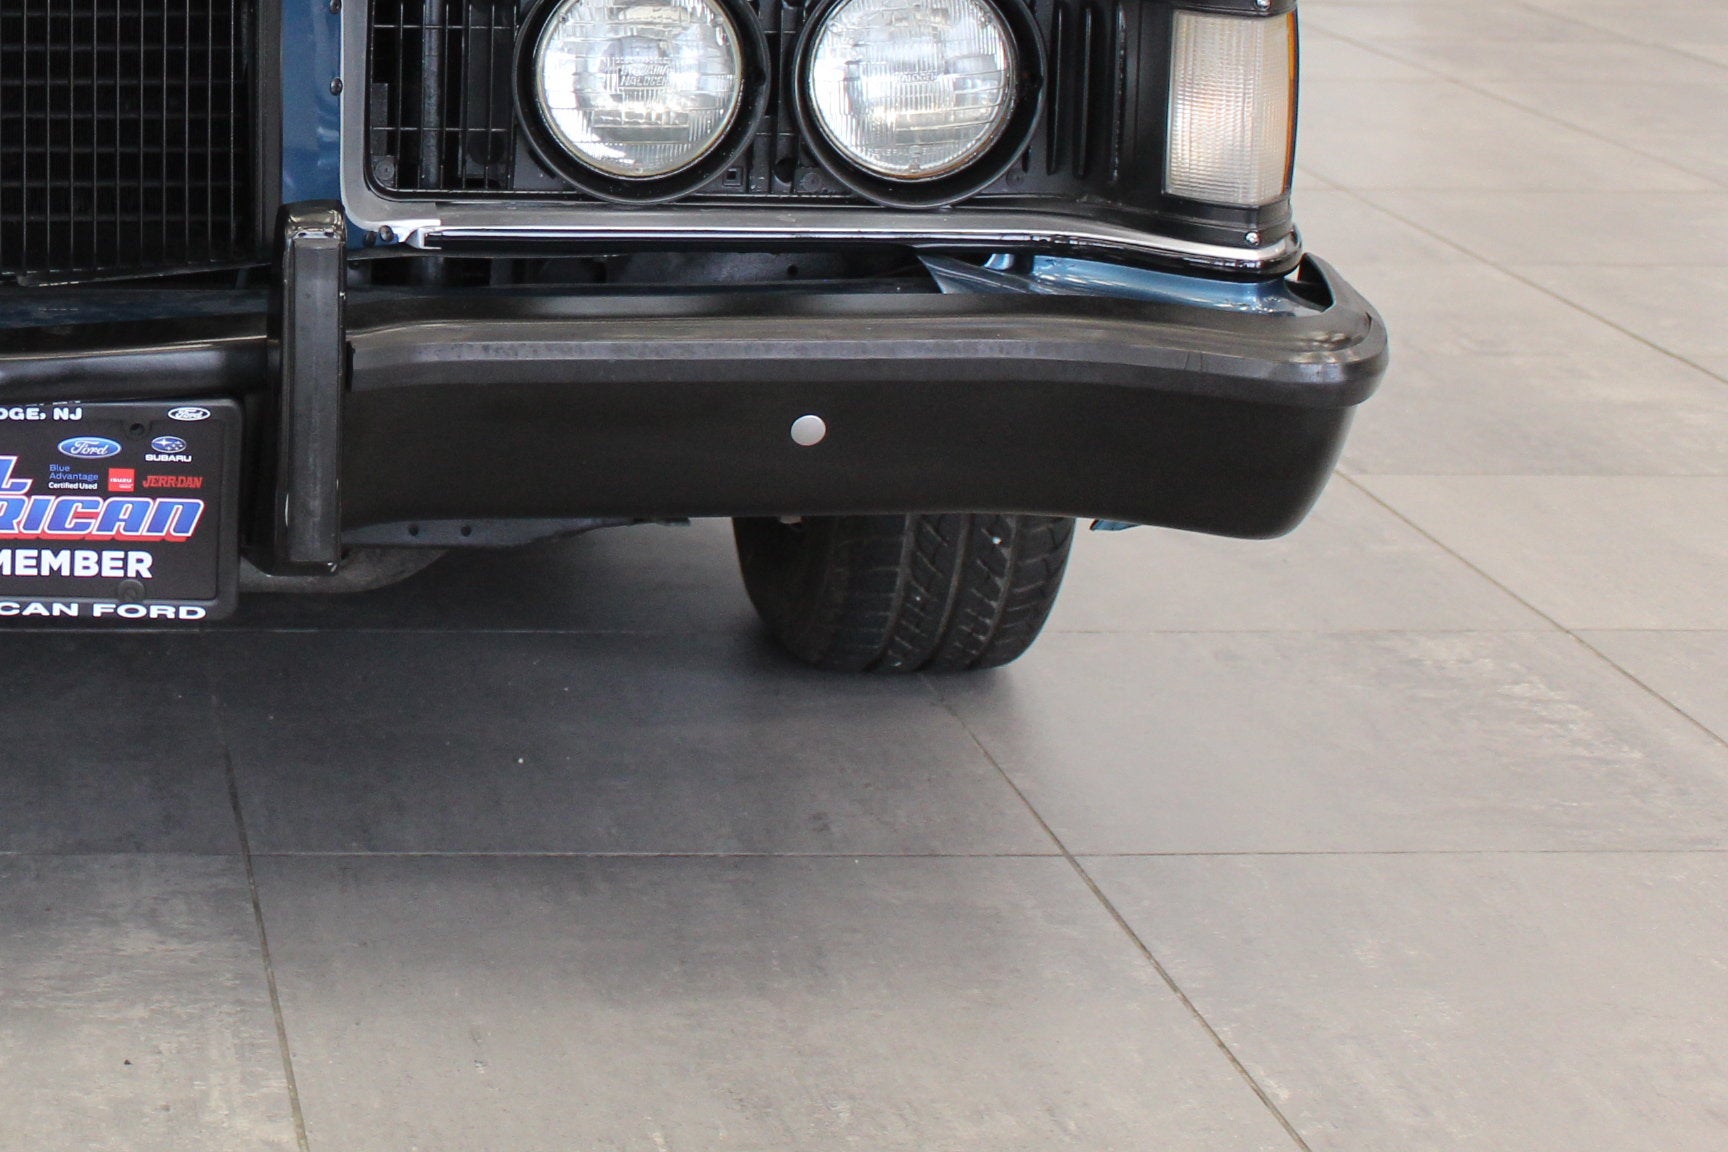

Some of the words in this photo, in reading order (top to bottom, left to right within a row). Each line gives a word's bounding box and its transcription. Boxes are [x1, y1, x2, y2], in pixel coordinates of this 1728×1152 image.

[53, 407, 83, 421] NJ
[145, 454, 192, 463] SUBARU
[49, 464, 71, 473] Blue
[49, 472, 99, 482] Advantage
[48, 481, 79, 490] Certified
[79, 482, 98, 490] Used
[92, 604, 207, 621] FORD
